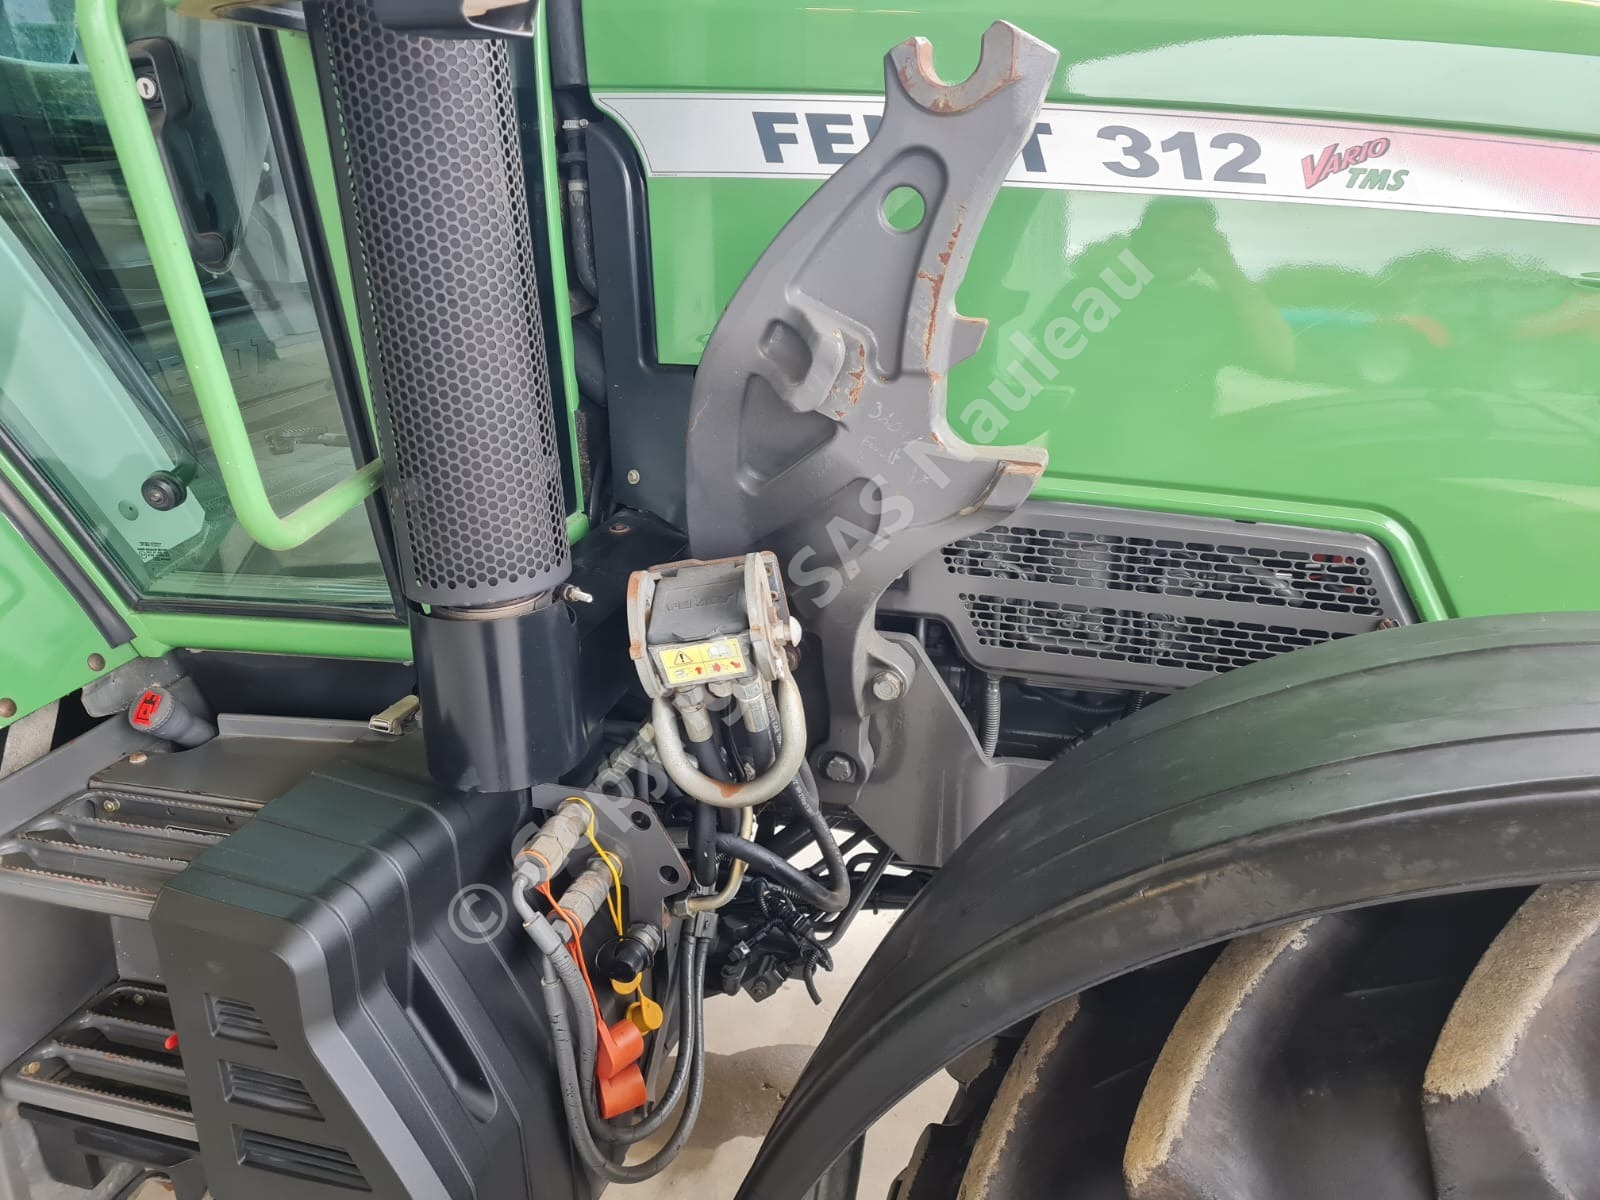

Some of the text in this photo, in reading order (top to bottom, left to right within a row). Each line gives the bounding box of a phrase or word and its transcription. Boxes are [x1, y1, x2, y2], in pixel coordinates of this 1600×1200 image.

[752, 111, 1267, 185] FET 312
[1301, 136, 1391, 190] VARIO
[1345, 167, 1410, 192] TMS
